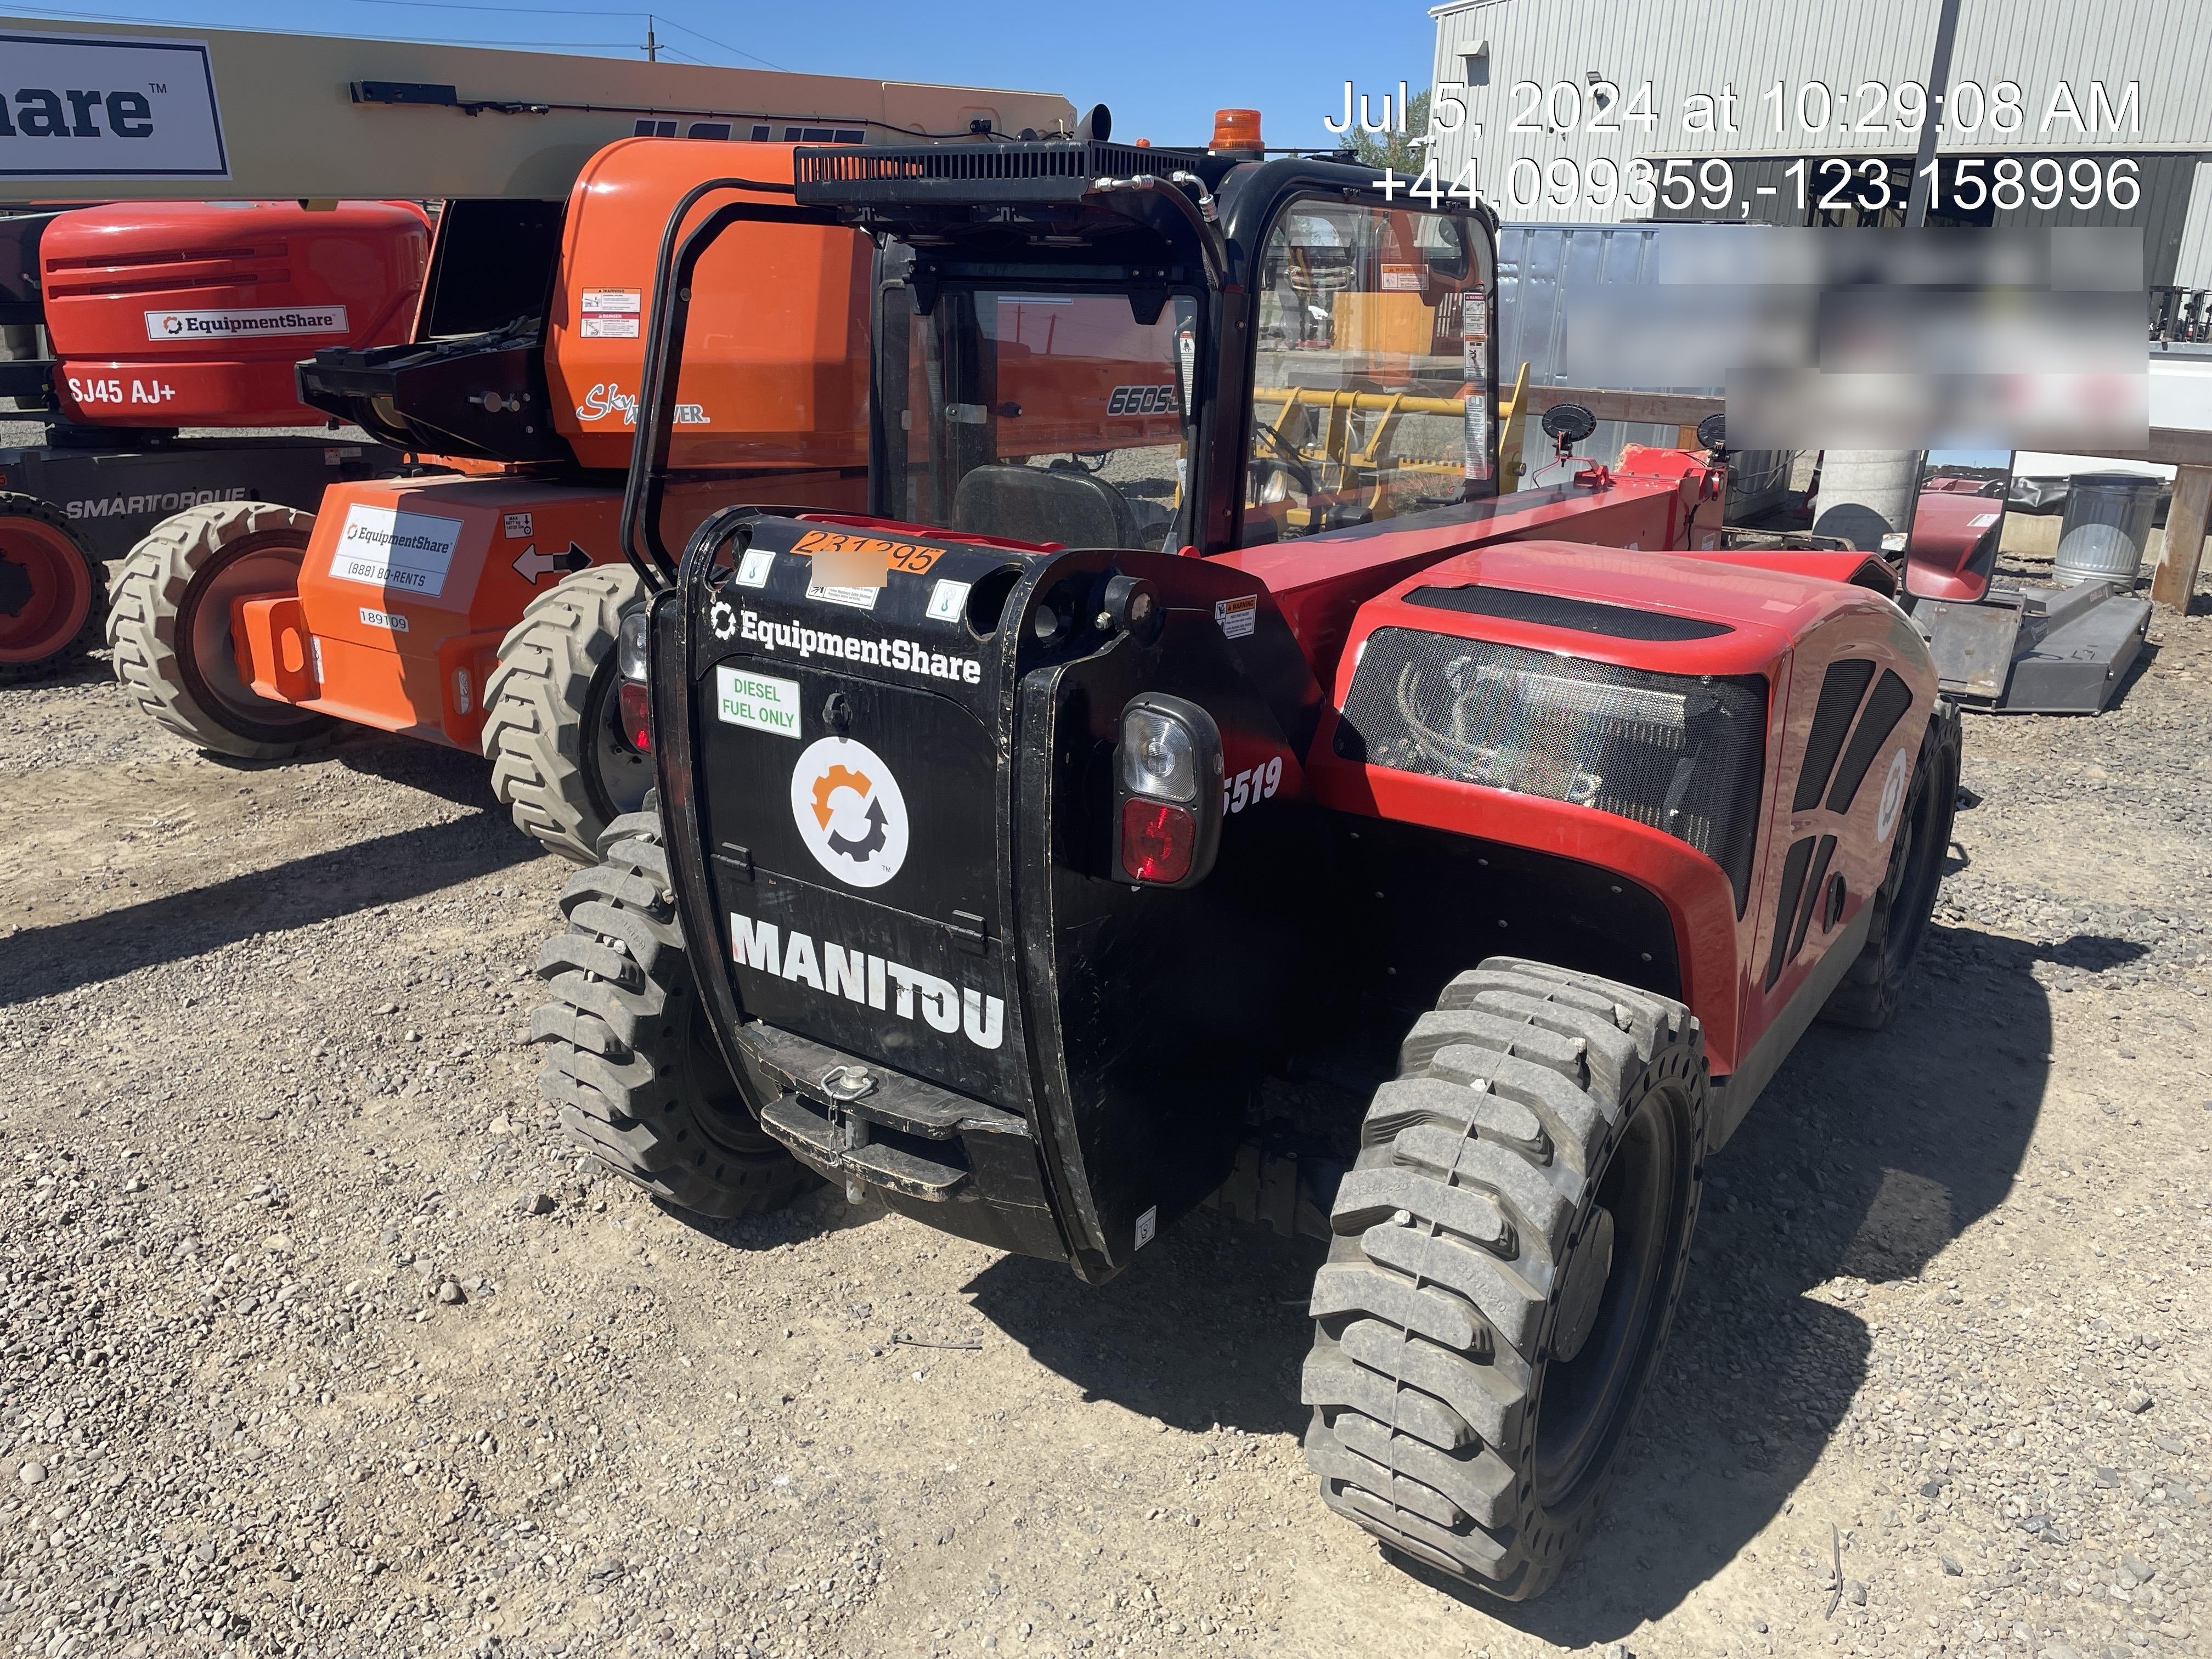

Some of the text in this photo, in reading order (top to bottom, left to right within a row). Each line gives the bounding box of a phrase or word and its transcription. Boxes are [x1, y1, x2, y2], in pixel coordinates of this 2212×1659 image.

[185, 314, 332, 334] EquipmentShare
[68, 378, 176, 404] SJ45 AJ+
[359, 527, 449, 554] EquipmentShare
[348, 562, 426, 586] (888) 80-RENTS
[360, 611, 406, 629] 189109
[741, 611, 981, 684] EquipmentShare
[733, 678, 781, 703] DIESEL
[723, 699, 794, 729] FUEL ONLY
[730, 912, 1004, 1049] MANITOU
